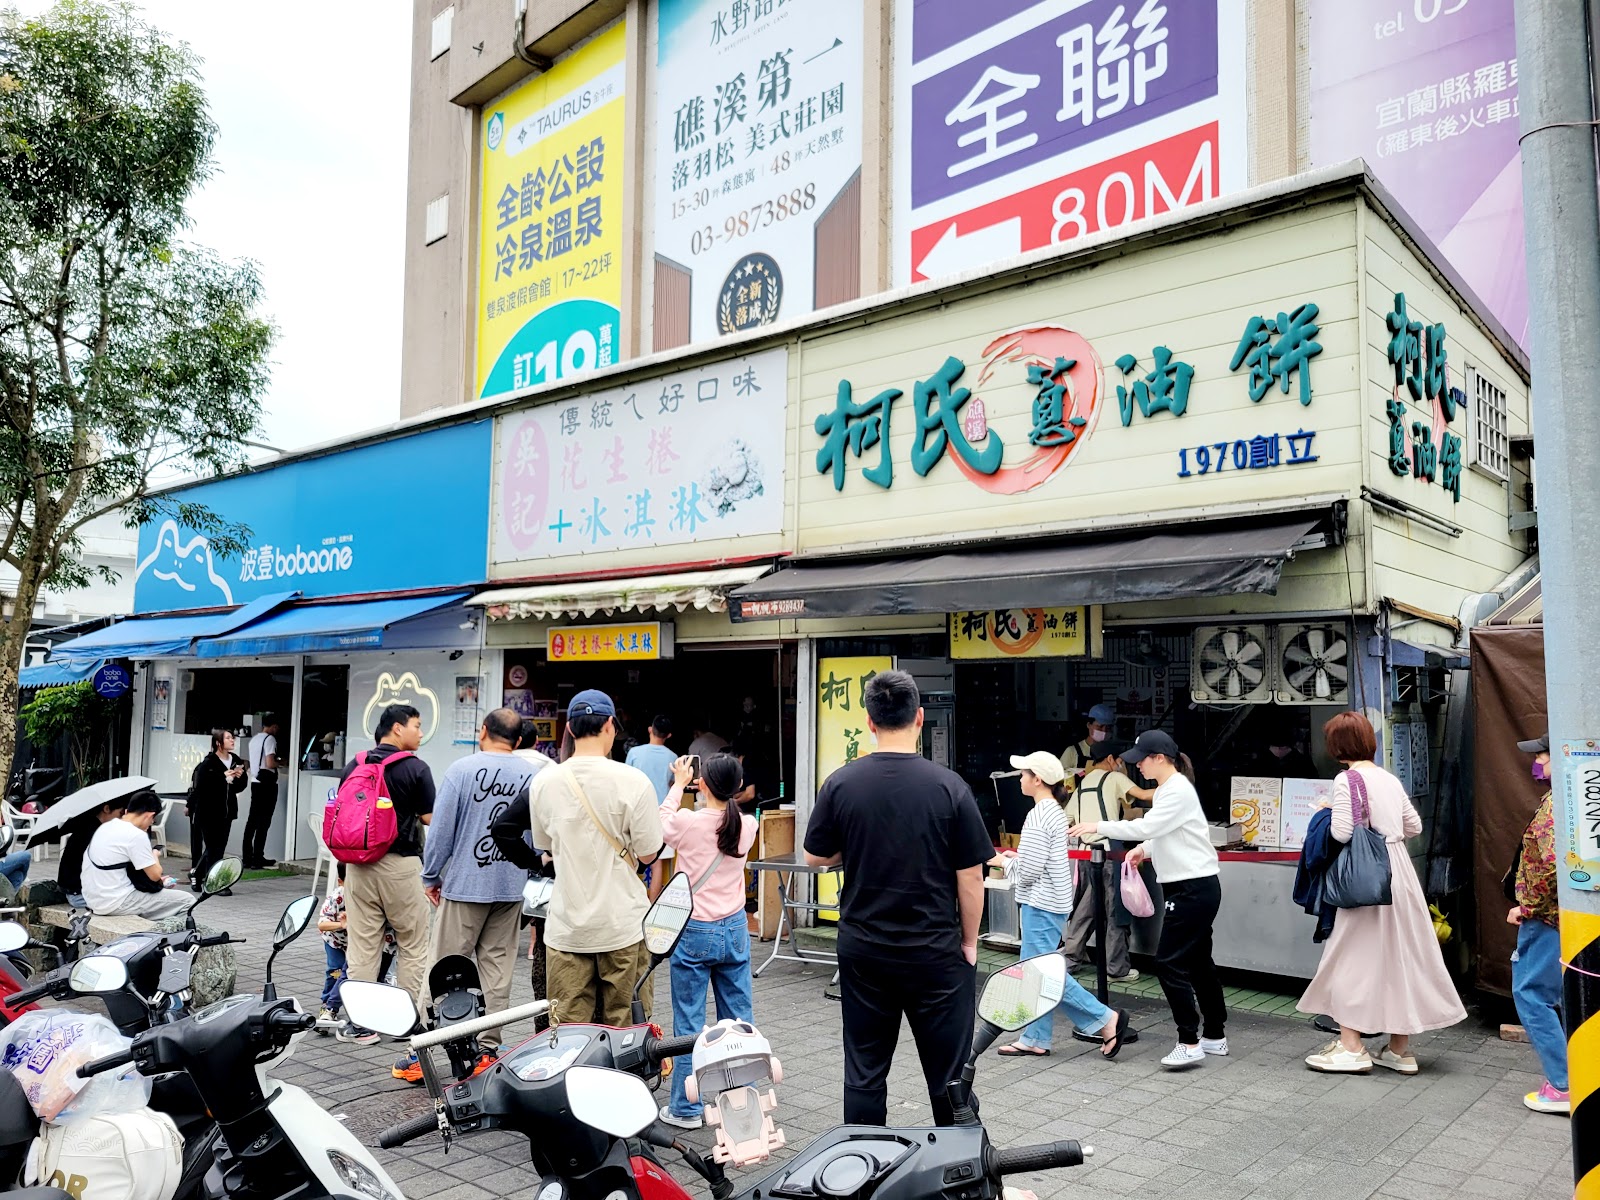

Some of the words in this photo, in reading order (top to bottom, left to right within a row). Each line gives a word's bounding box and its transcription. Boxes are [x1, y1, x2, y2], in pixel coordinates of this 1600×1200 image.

[710, 0, 793, 47] 水野路
[1373, 11, 1405, 40] tel
[537, 90, 592, 136] TAURUS
[673, 37, 843, 154] 礁溪第一
[945, 0, 1168, 178] 全聯
[672, 137, 735, 192] 落羽松
[745, 82, 844, 160] 美式莊園
[497, 136, 605, 231] 全齡公設
[691, 182, 816, 256] 03-9873888
[1051, 140, 1213, 246] 80M
[495, 195, 604, 282] 冷泉溫泉
[1386, 292, 1456, 422] 柯氏
[560, 426, 681, 492] 花生捲
[1177, 427, 1320, 478] 1970創立
[275, 544, 353, 577] bobaone
